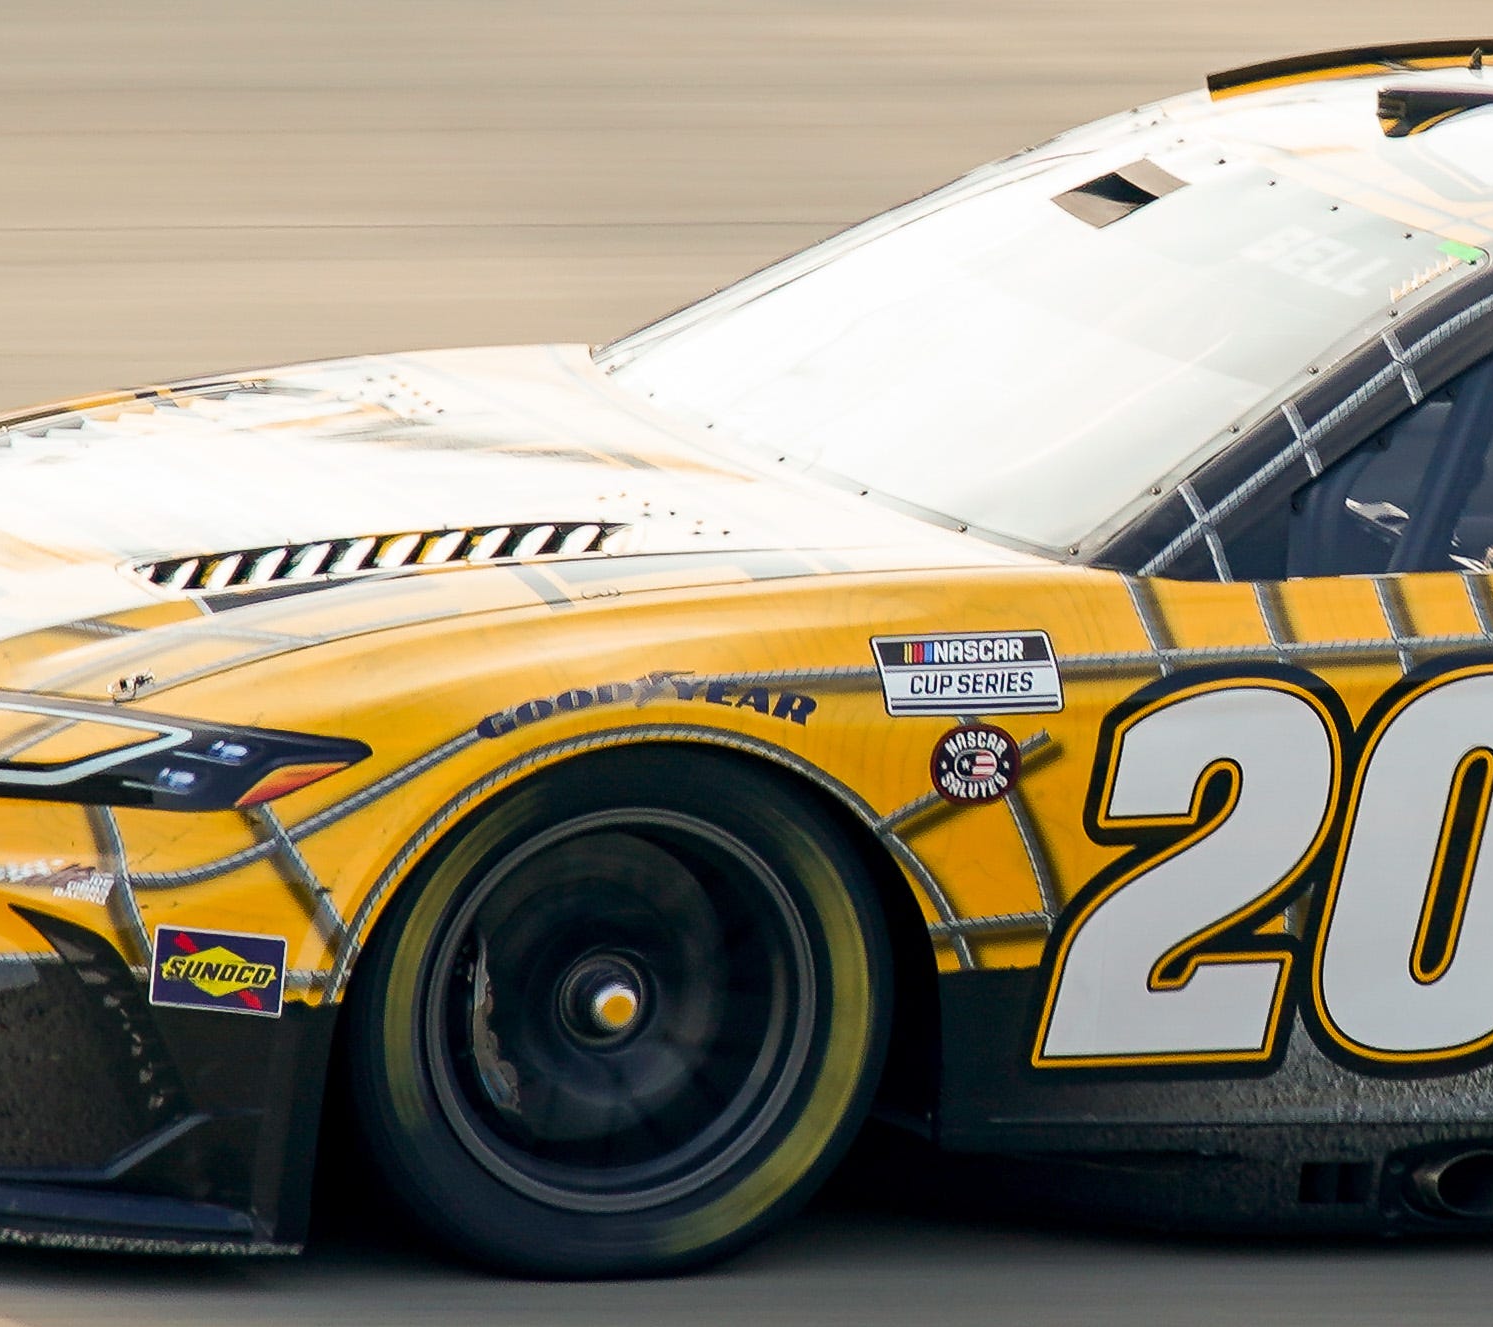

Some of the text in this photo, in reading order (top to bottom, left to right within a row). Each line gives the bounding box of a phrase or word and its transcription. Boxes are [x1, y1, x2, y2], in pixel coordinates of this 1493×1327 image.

[933, 638, 1025, 664] NASCAR
[910, 671, 1034, 695] CUP SERIES
[944, 731, 1009, 759] NASCAR
[940, 770, 1009, 799] SALUTES
[166, 956, 276, 987] SUNOCO
